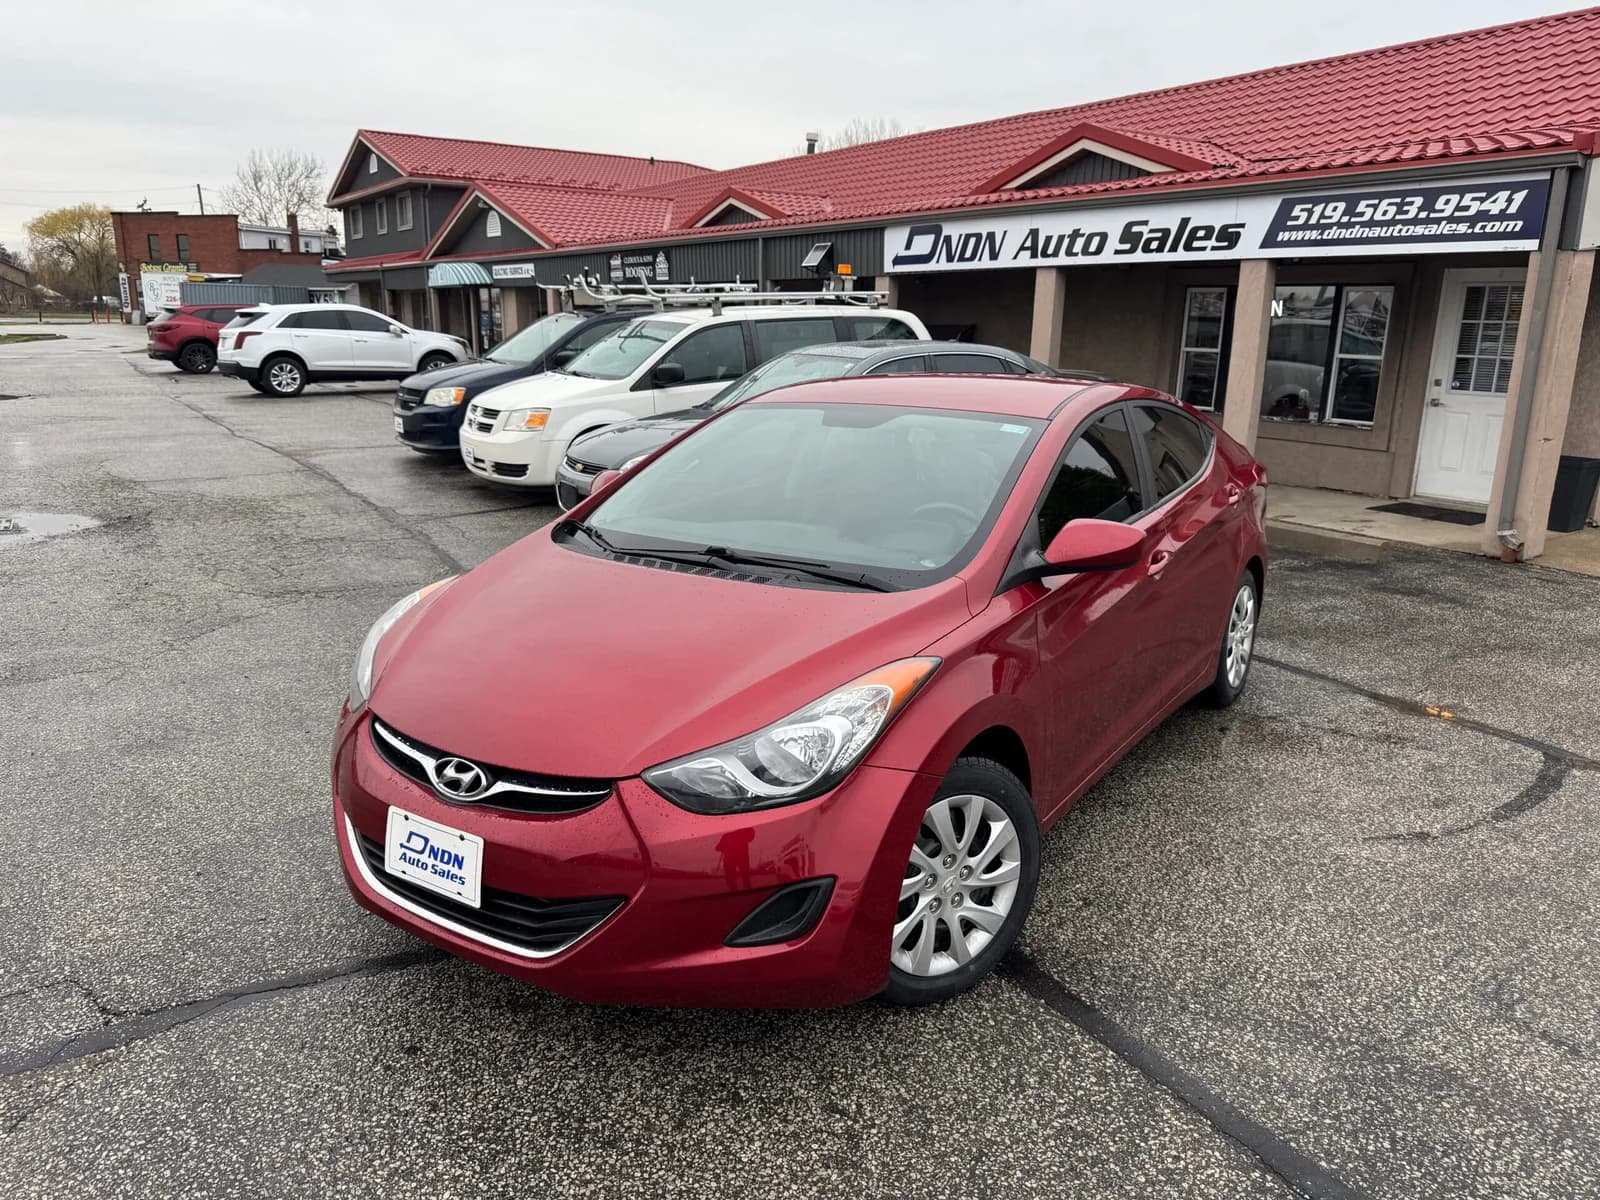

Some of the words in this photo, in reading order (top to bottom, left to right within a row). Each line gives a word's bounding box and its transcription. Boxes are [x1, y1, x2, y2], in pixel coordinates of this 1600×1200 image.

[1286, 189, 1529, 226] 519.563.9541
[892, 223, 1008, 270] DNDN
[1012, 227, 1108, 260] Auto
[1114, 217, 1246, 255] Sales
[1276, 220, 1524, 241] www.dndnautosales.com
[120, 277, 130, 309] Quartz
[399, 830, 465, 871] DNDN
[399, 852, 428, 871] Auto
[430, 864, 466, 886] Sales
